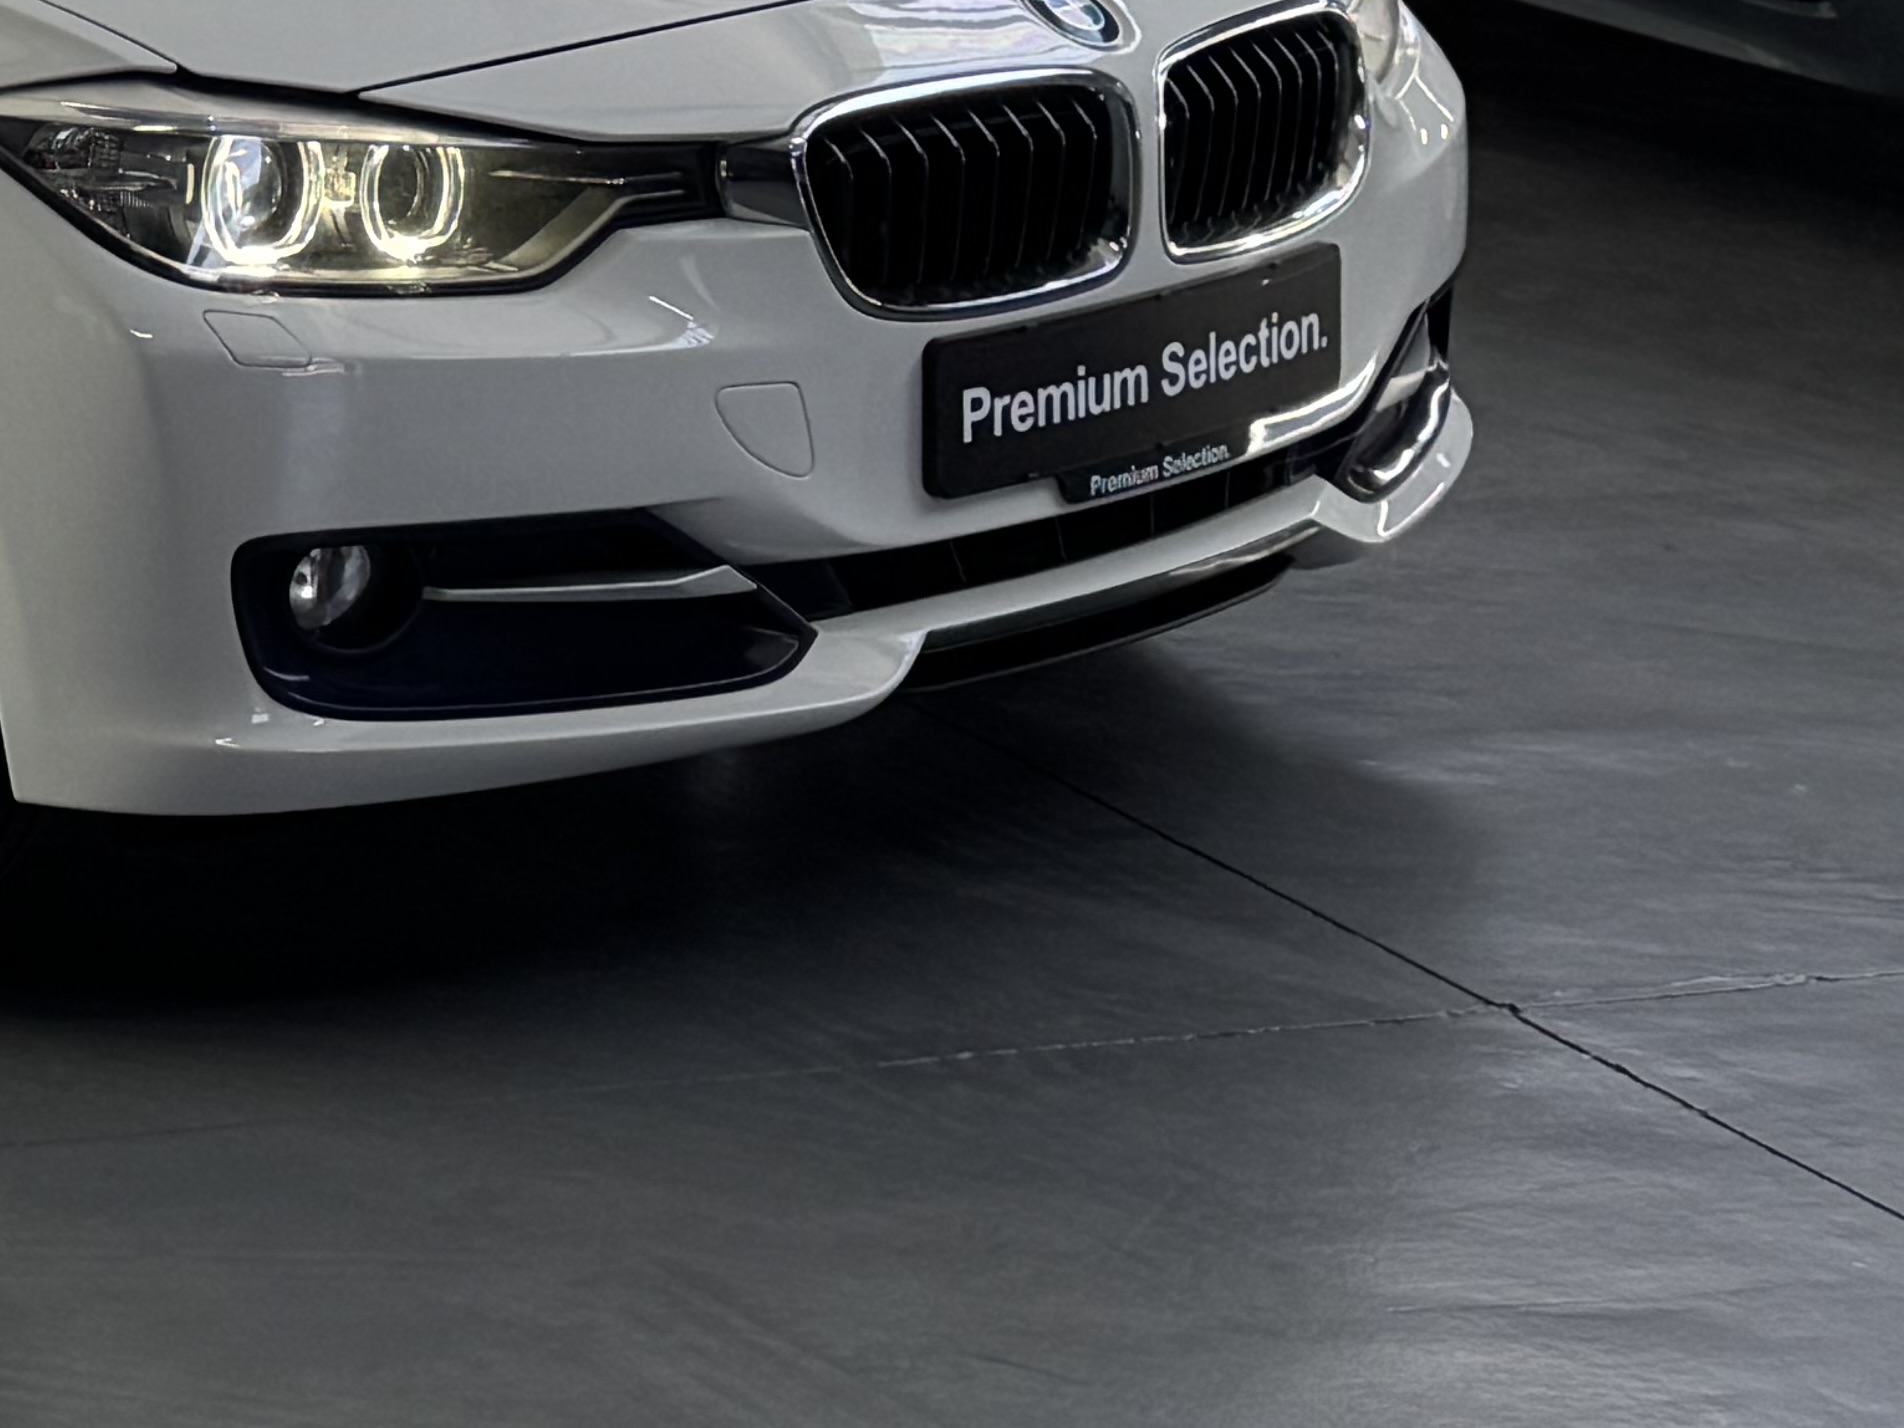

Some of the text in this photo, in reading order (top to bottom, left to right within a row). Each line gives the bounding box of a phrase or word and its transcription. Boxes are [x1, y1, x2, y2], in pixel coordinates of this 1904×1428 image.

[961, 312, 1329, 444] Premium Selection.
[1090, 465, 1159, 497] Premium
